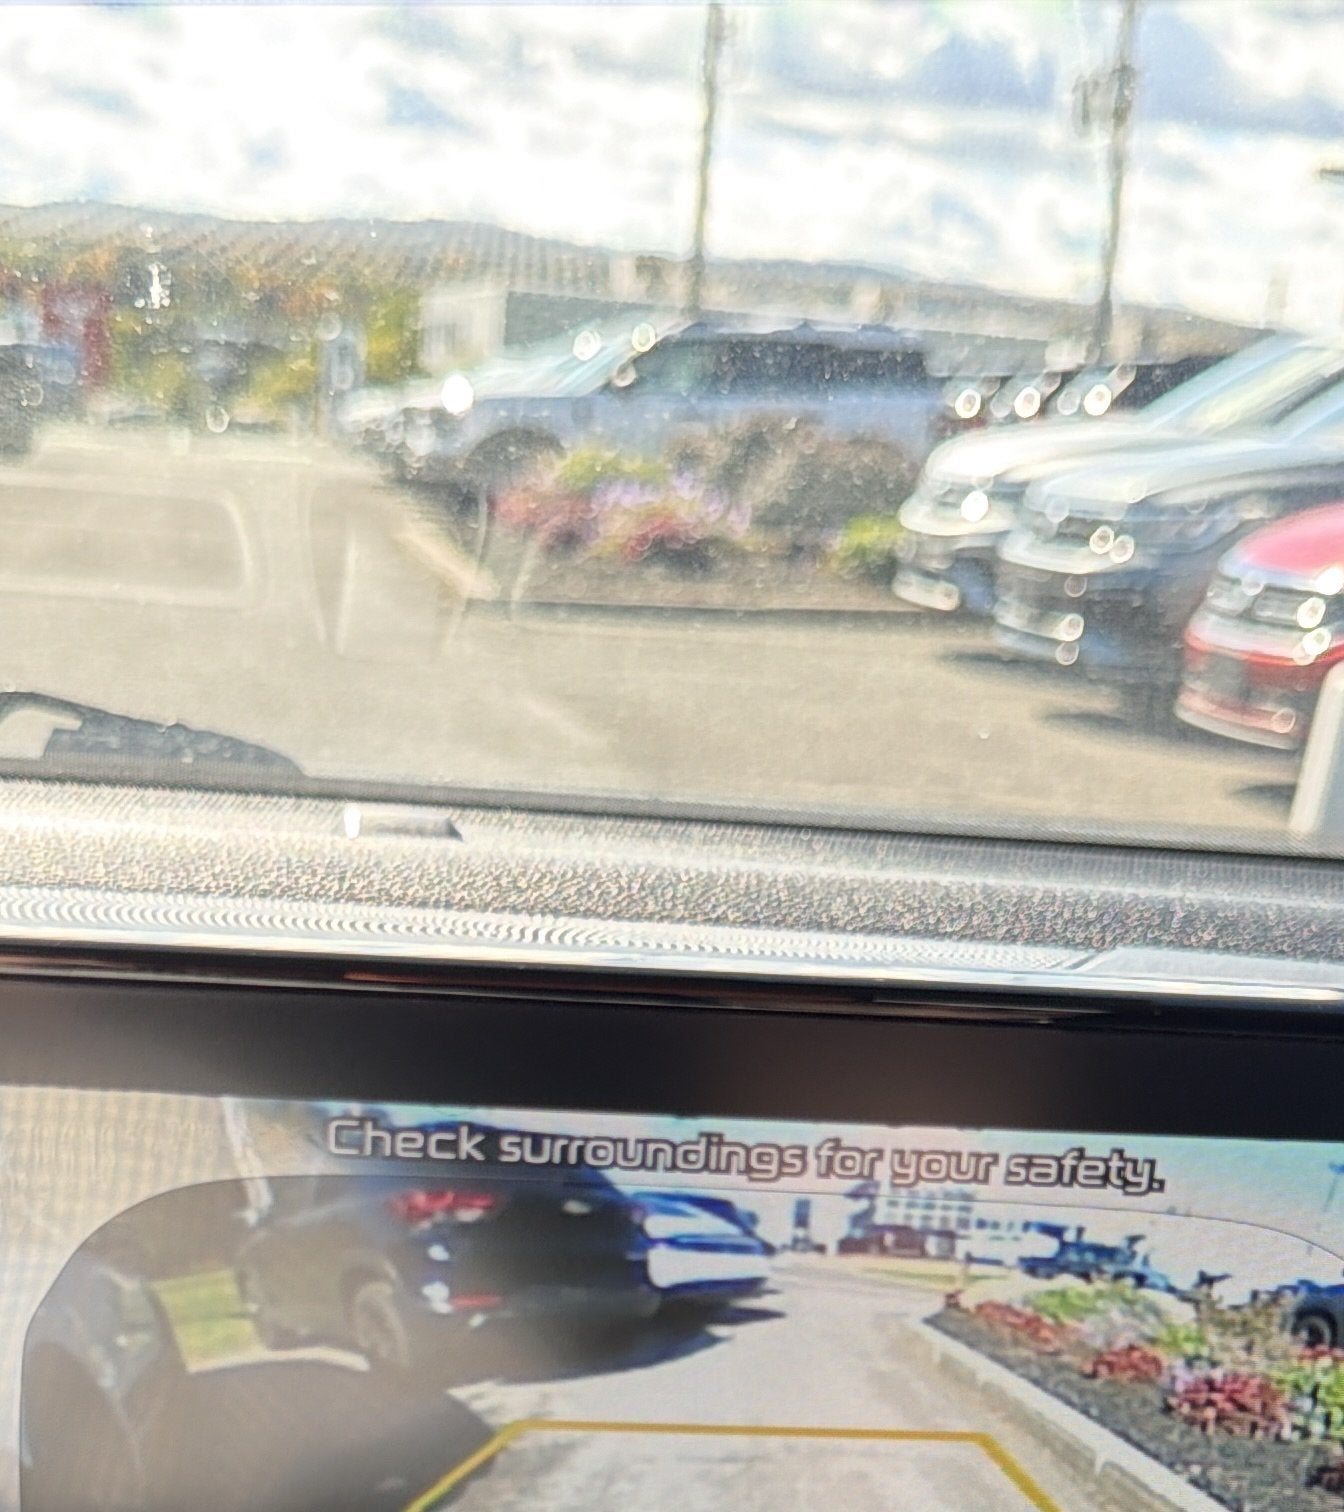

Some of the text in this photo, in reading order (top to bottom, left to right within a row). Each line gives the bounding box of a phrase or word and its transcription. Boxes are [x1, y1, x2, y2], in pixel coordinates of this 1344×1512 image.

[326, 1118, 1166, 1196] Check surroundings for your safety.
